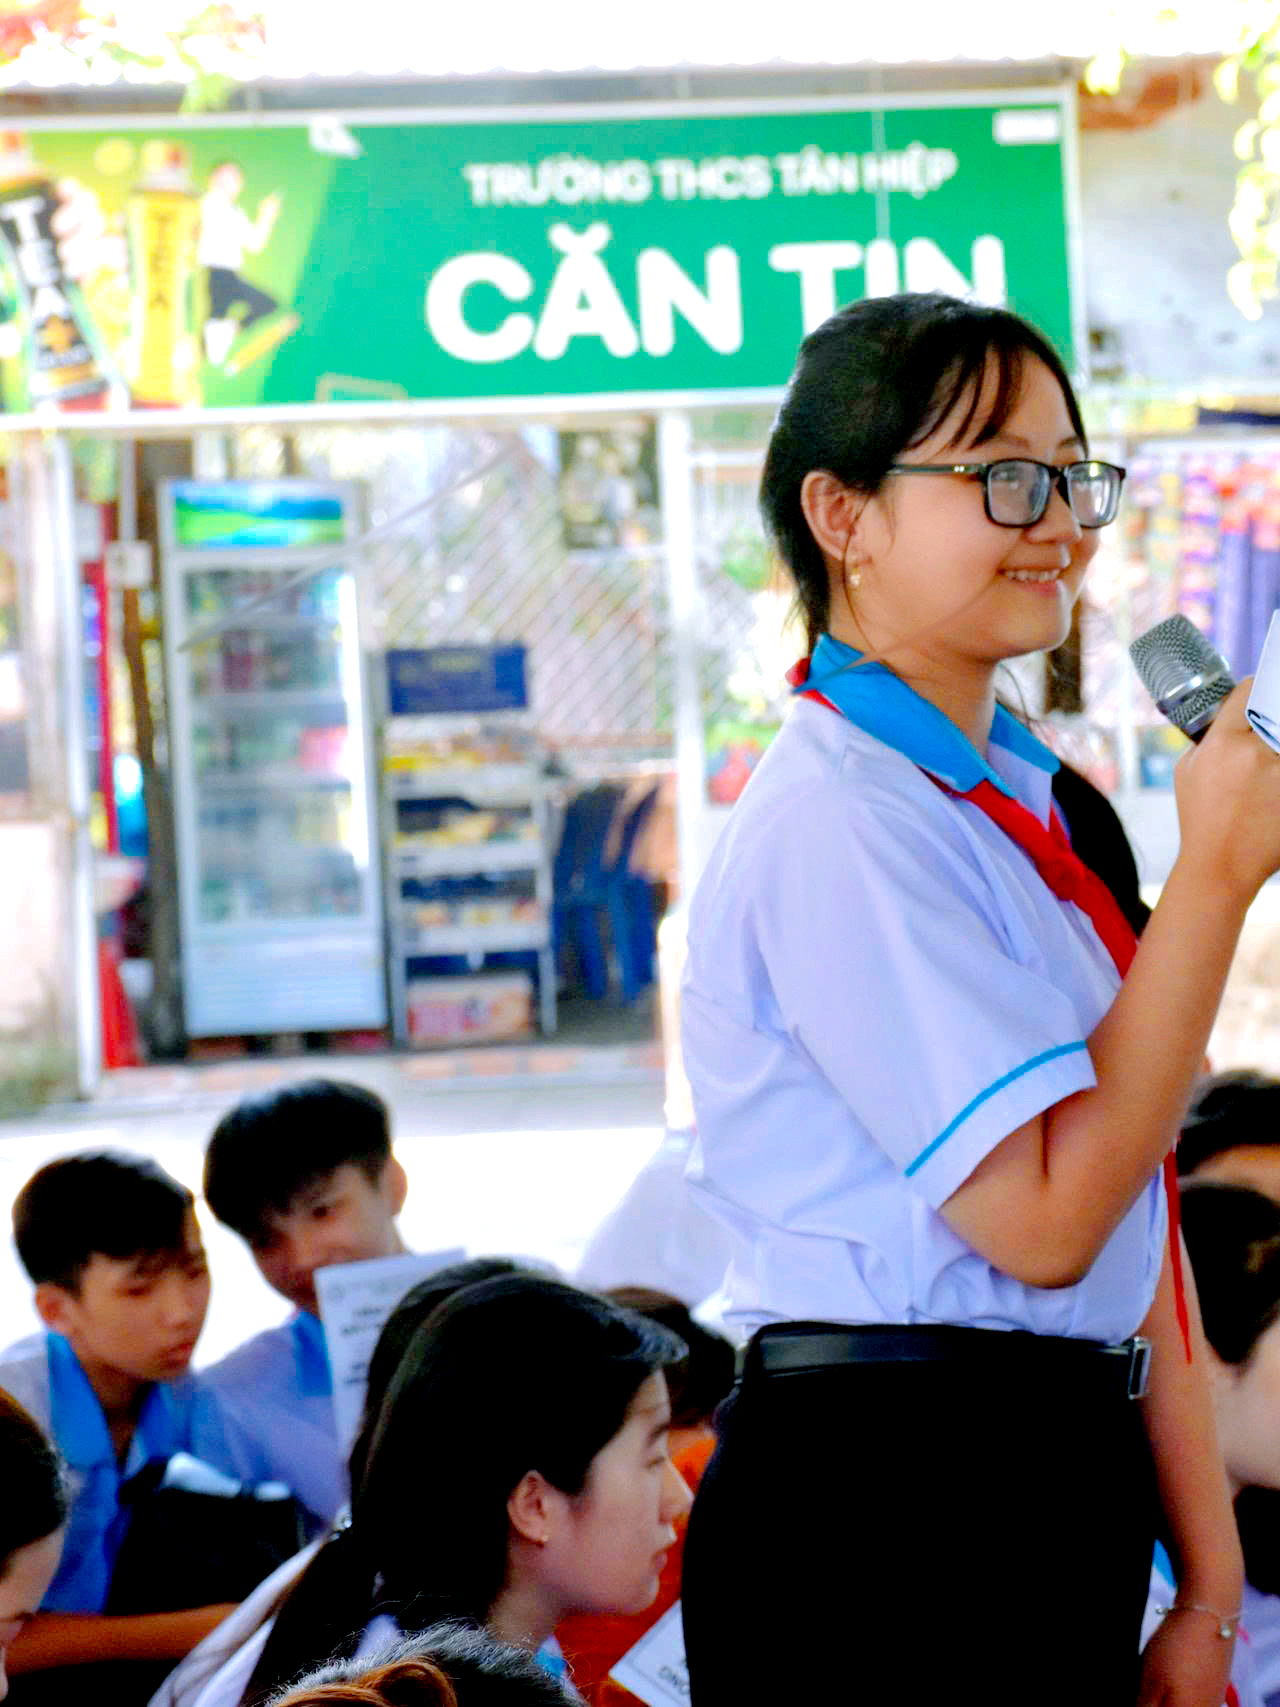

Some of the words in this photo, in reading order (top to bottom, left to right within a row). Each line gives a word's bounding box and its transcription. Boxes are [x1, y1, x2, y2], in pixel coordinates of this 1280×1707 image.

[465, 152, 651, 206] TRƯỜNG
[655, 155, 773, 201] THCS
[775, 144, 859, 197] TÂN
[862, 140, 958, 200] HIỆP
[426, 223, 746, 361] CĂN
[768, 234, 1007, 335] TIN
